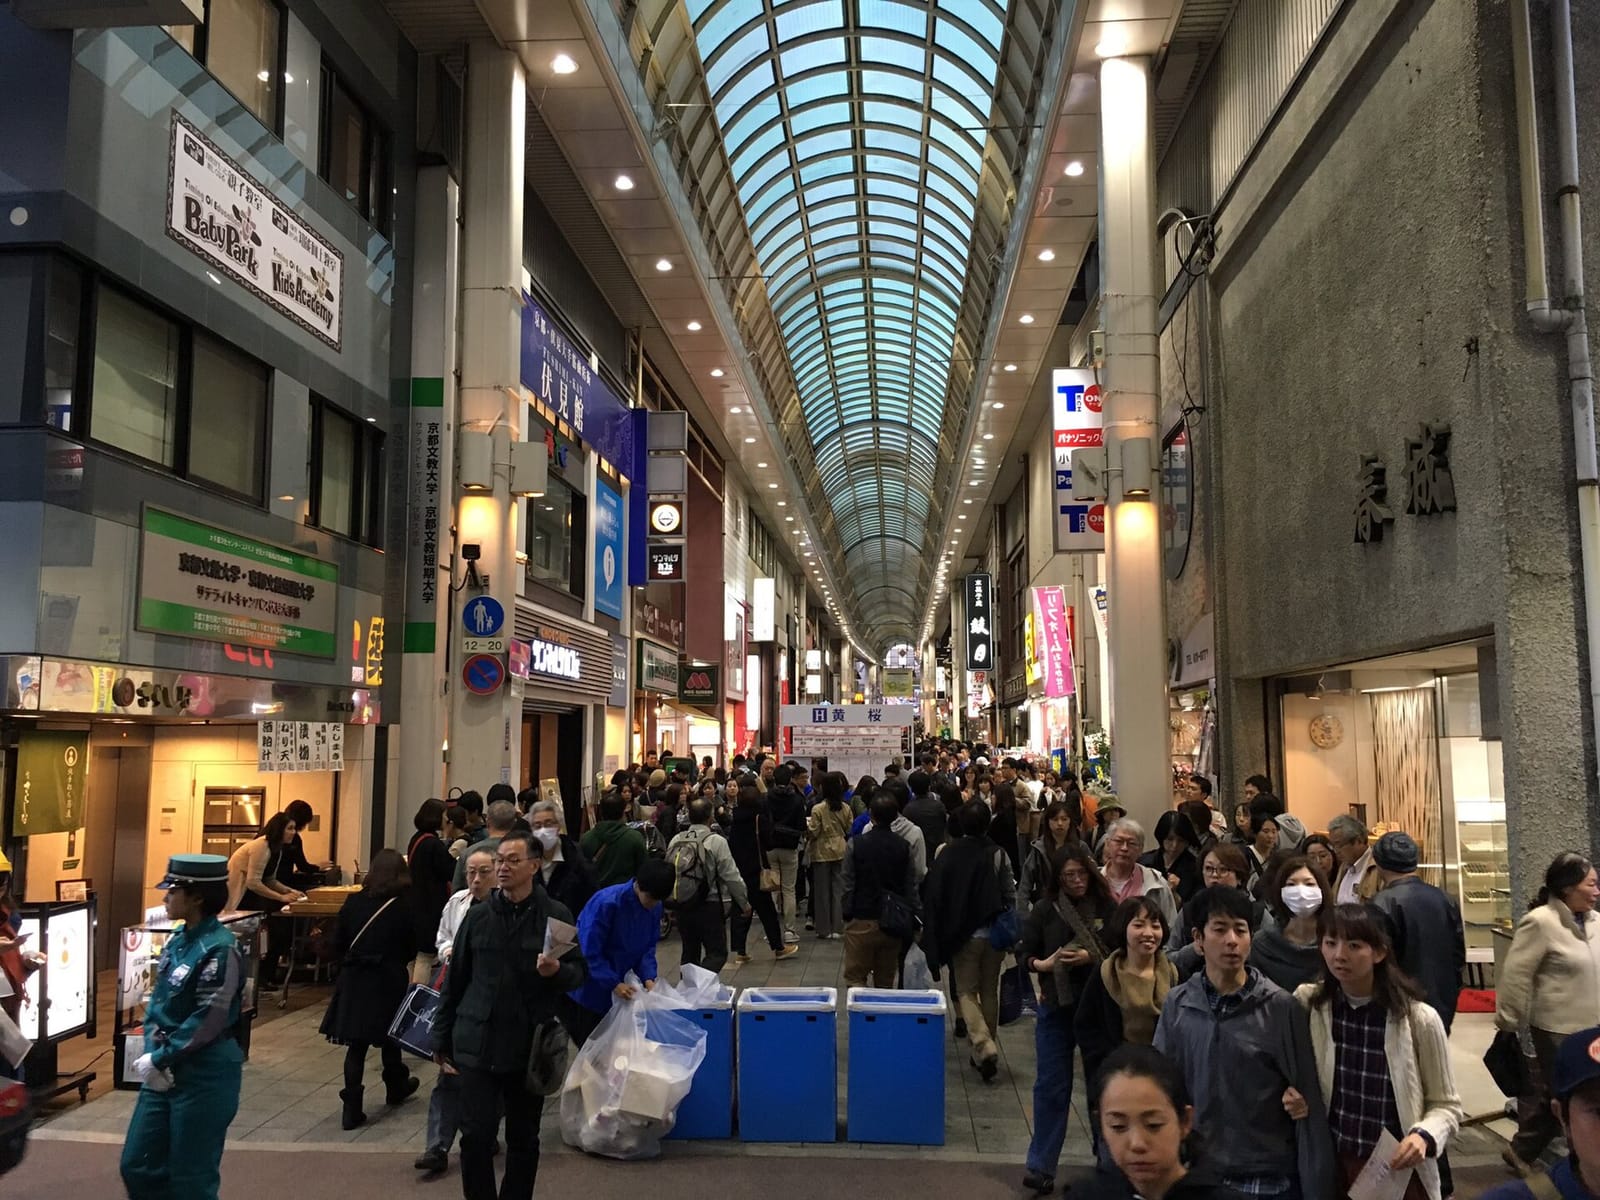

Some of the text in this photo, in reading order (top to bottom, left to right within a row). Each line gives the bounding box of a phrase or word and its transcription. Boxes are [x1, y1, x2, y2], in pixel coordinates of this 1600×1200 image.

[541, 360, 584, 433] 伏見館
[422, 422, 440, 604] 京都文教大学・京都文教短期大学
[280, 722, 290, 761] ねり天
